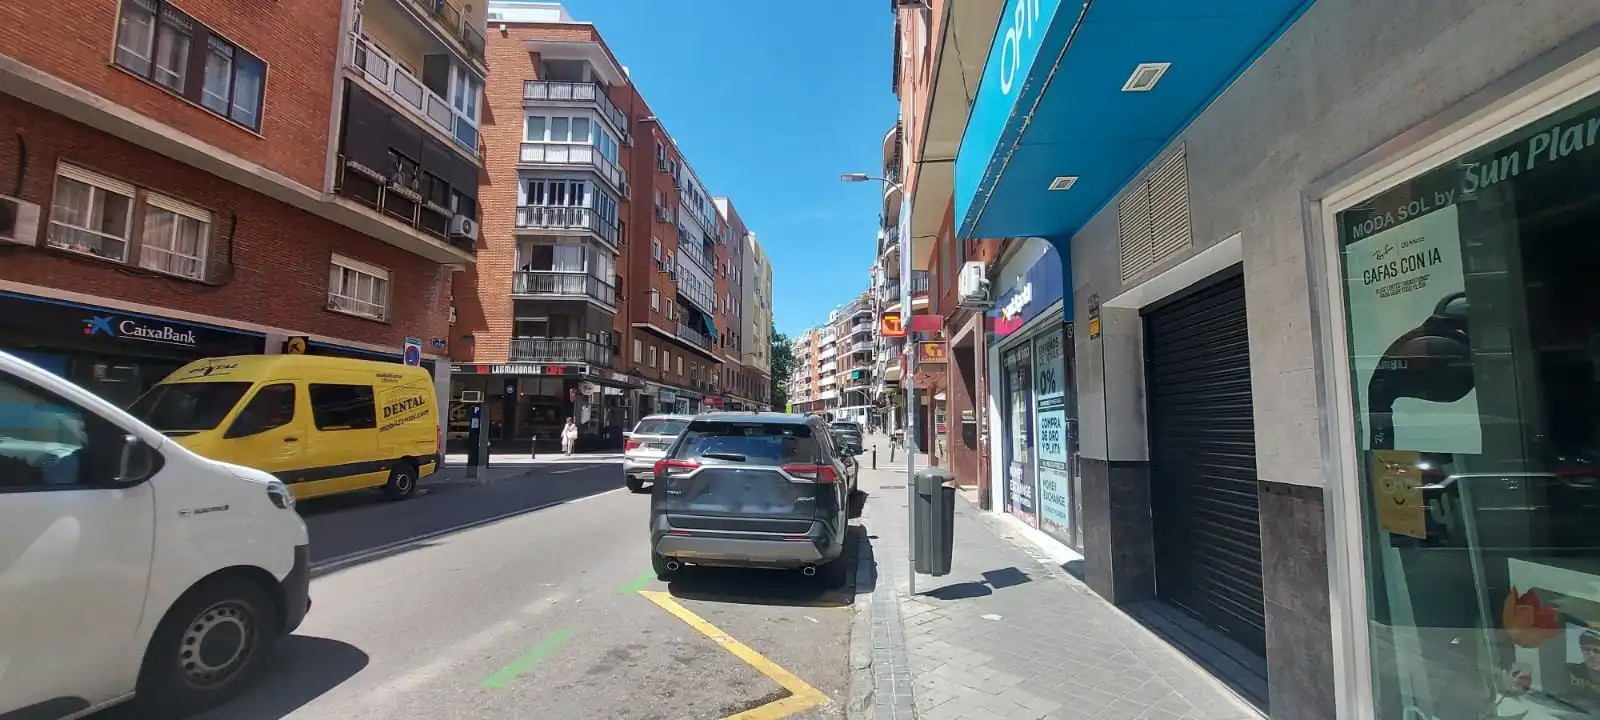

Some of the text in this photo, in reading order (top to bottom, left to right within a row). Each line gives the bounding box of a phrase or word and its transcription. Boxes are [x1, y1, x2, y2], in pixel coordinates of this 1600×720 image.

[1352, 211, 1395, 239] MODA
[1398, 197, 1430, 221] SOL
[1435, 189, 1455, 206] by
[1463, 151, 1519, 193] Sun
[1363, 247, 1442, 285] GAFAS CON IA
[119, 321, 196, 344] CaixaBank
[1040, 368, 1056, 395] 0%
[383, 396, 425, 418] DENTAL
[1041, 416, 1061, 429] COMPRA
[1041, 430, 1059, 441] DE ORO
[1046, 443, 1060, 456] PLATA
[1043, 491, 1066, 507] EXCHANGE
